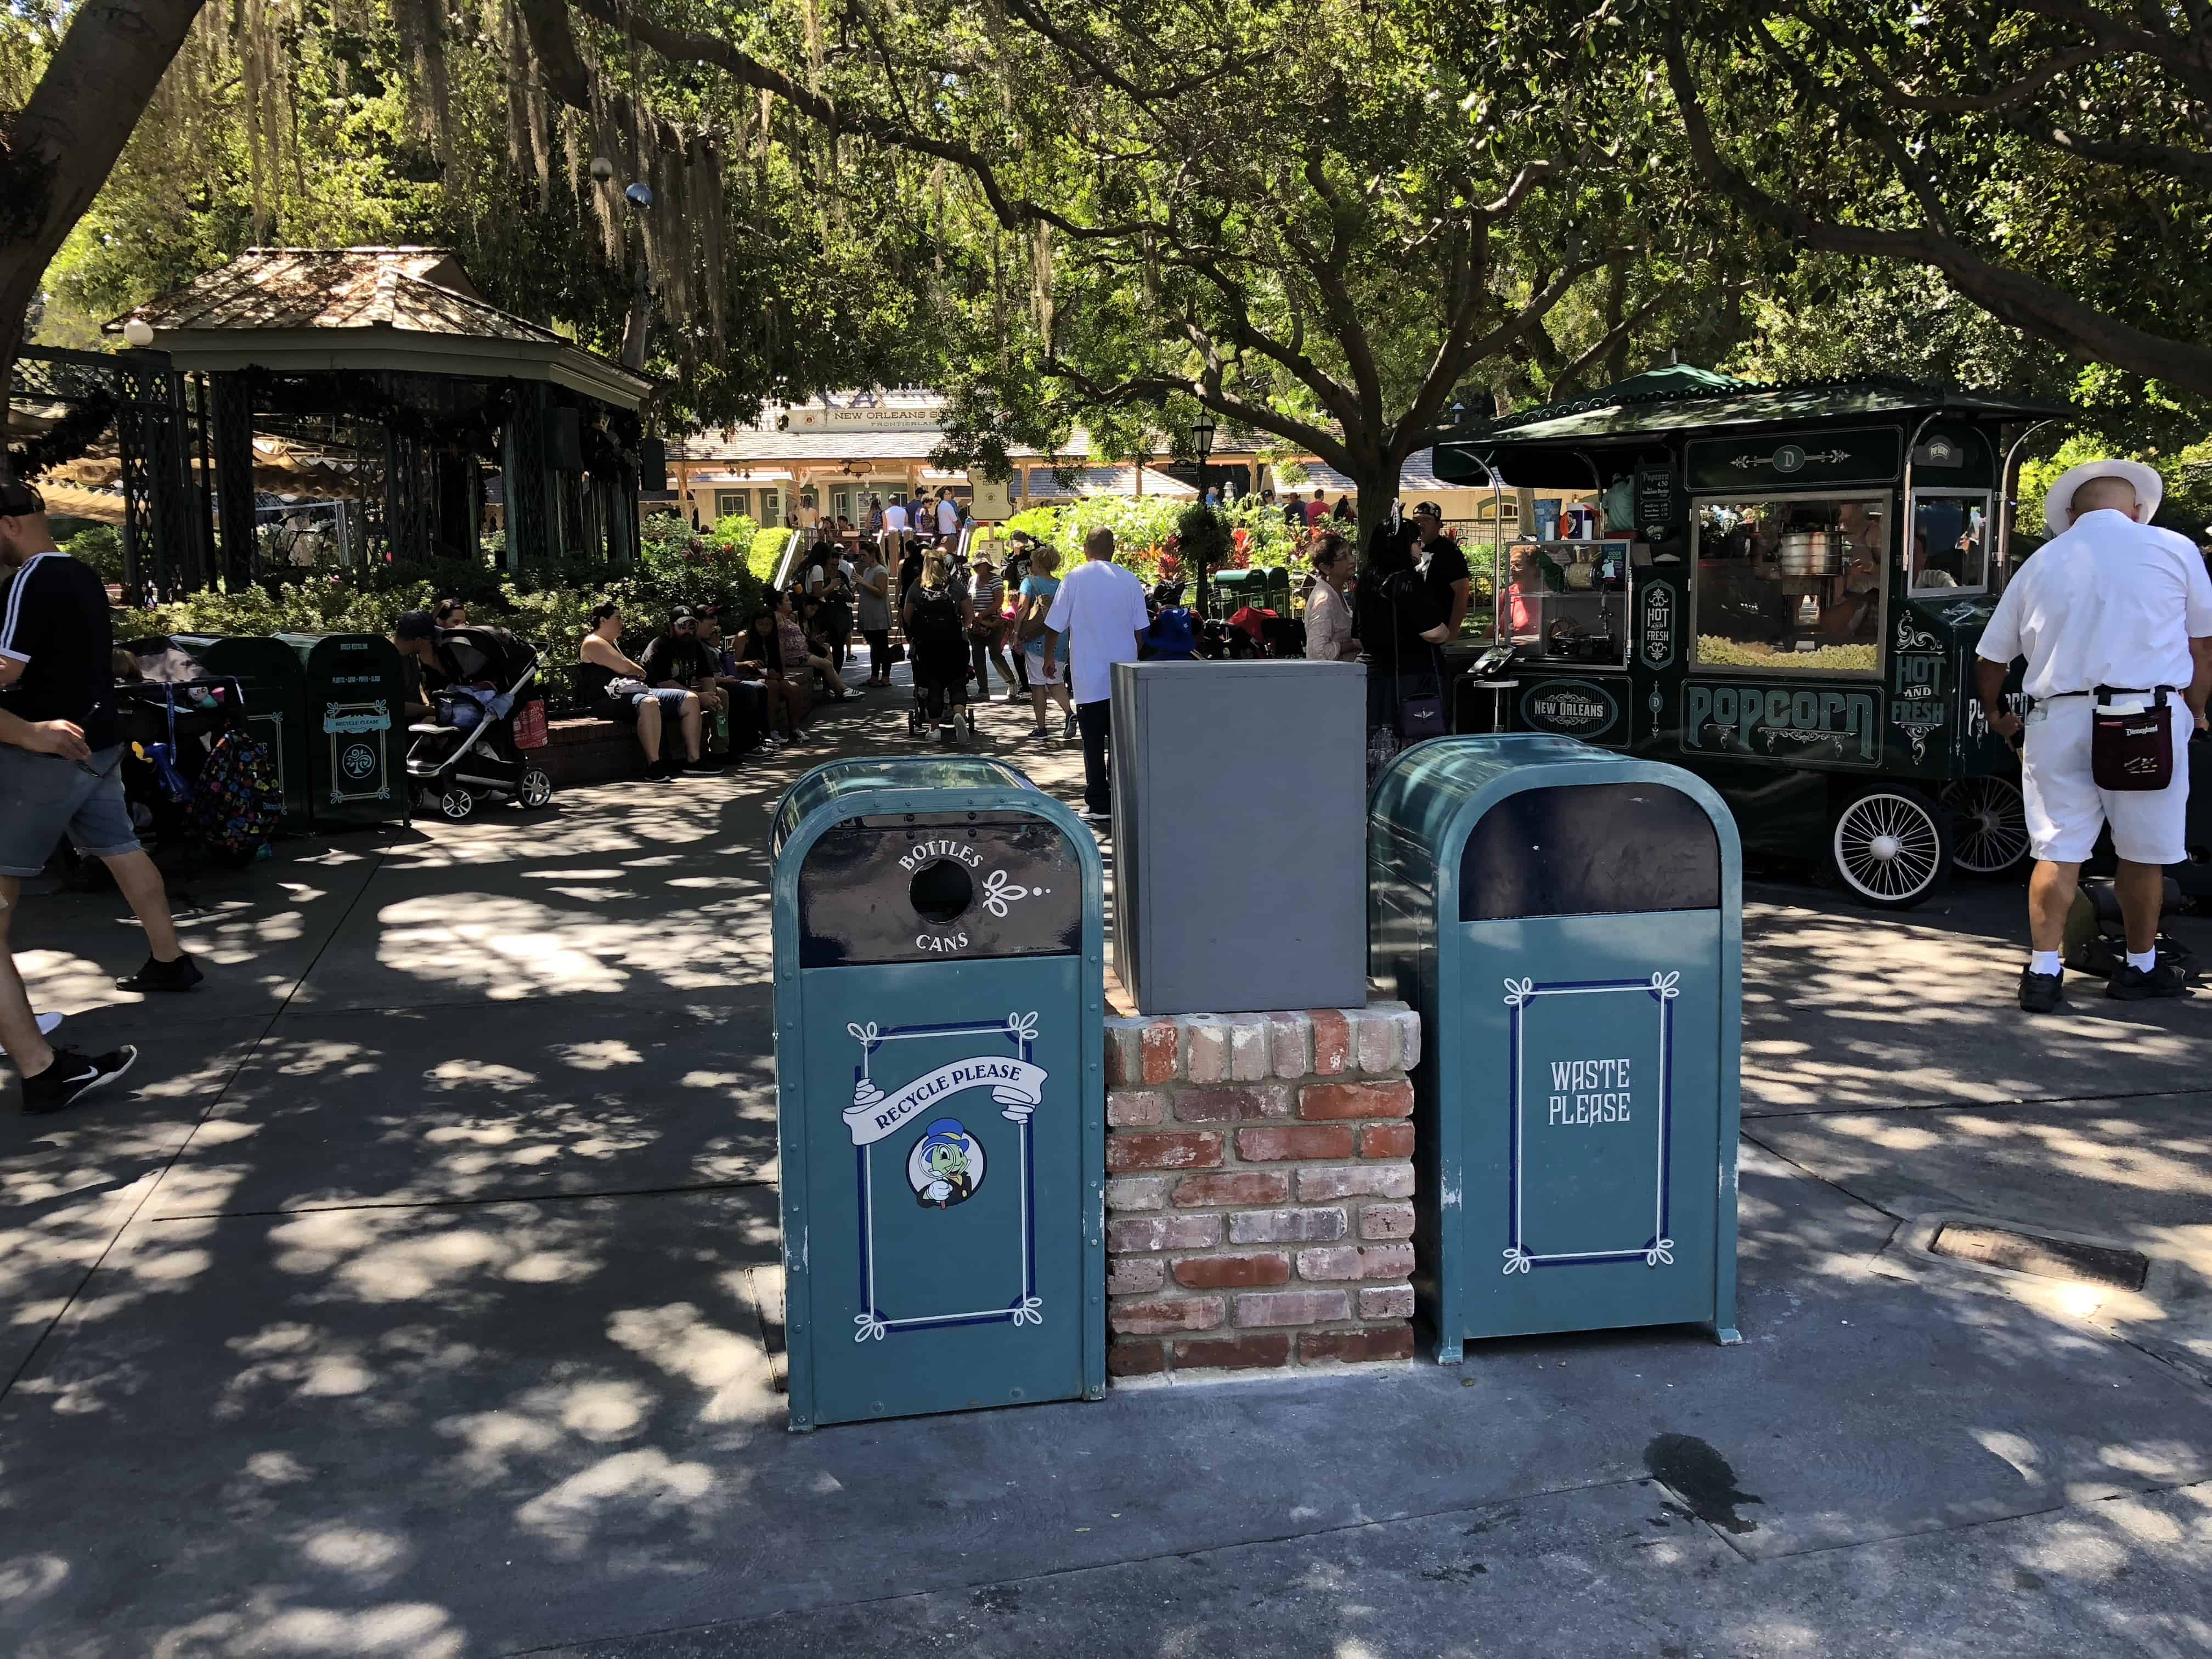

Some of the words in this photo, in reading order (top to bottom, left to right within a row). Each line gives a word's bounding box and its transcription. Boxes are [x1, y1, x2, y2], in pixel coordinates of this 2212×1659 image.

[1647, 608, 1669, 628] HOT
[1647, 631, 1669, 641] FRESH
[1895, 656, 1946, 697] HOT
[1653, 697, 1660, 707] D
[1903, 687, 1932, 698] AND
[1534, 701, 1556, 715] NEW
[1560, 702, 1604, 717] ORLEANS
[1891, 701, 1944, 723] FRESH
[898, 840, 984, 871] BOTTLES
[916, 932, 968, 952] CANS
[1550, 1058, 1630, 1094] WASTE
[874, 1076, 949, 1130] RECYCLE
[951, 1064, 1022, 1085] PLEASE
[1549, 1092, 1630, 1128] PLEASE
